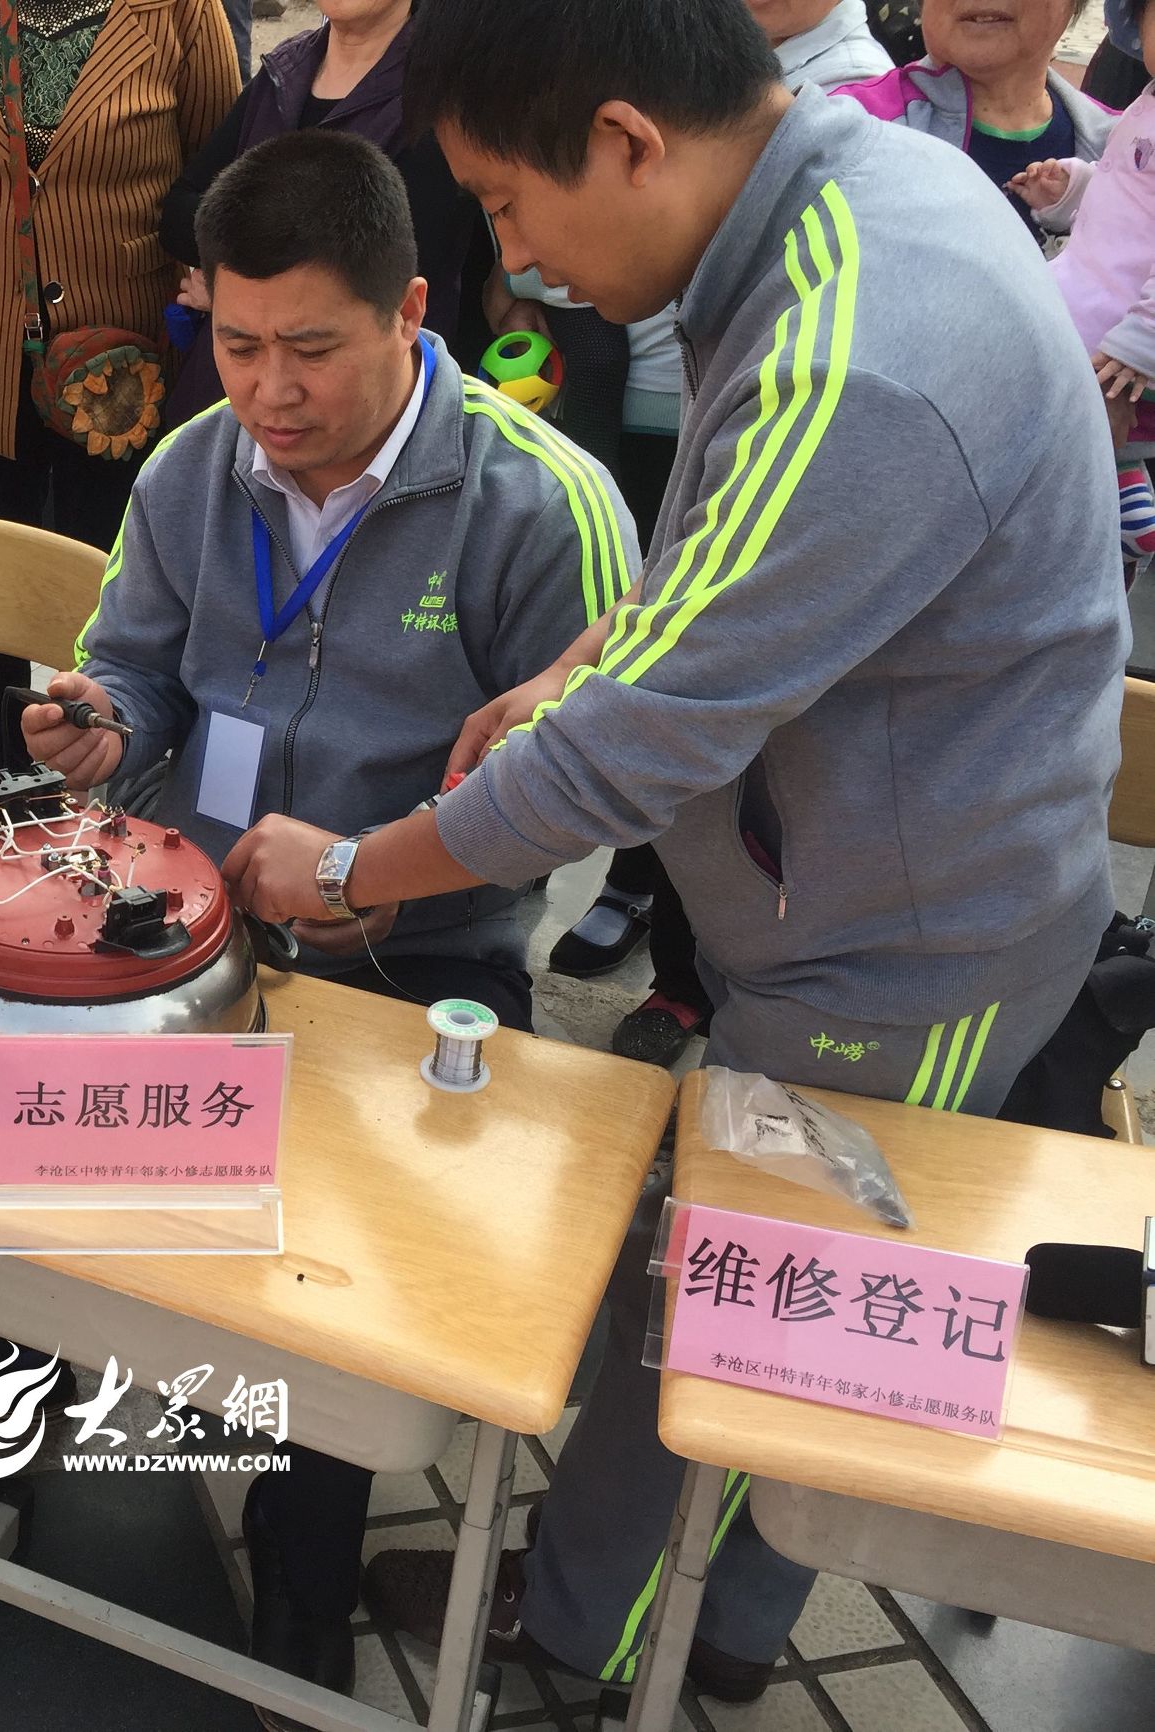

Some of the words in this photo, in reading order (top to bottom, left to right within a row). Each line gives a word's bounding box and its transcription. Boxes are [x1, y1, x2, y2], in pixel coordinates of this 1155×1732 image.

[13, 1081, 255, 1129] 志愿服务
[34, 1164, 273, 1178] 李沧区中特青年邻家小修志愿服务队
[684, 1237, 1009, 1363] 维修登记
[710, 1352, 996, 1427] 李沧区中特青年邻家小修志愿服务队
